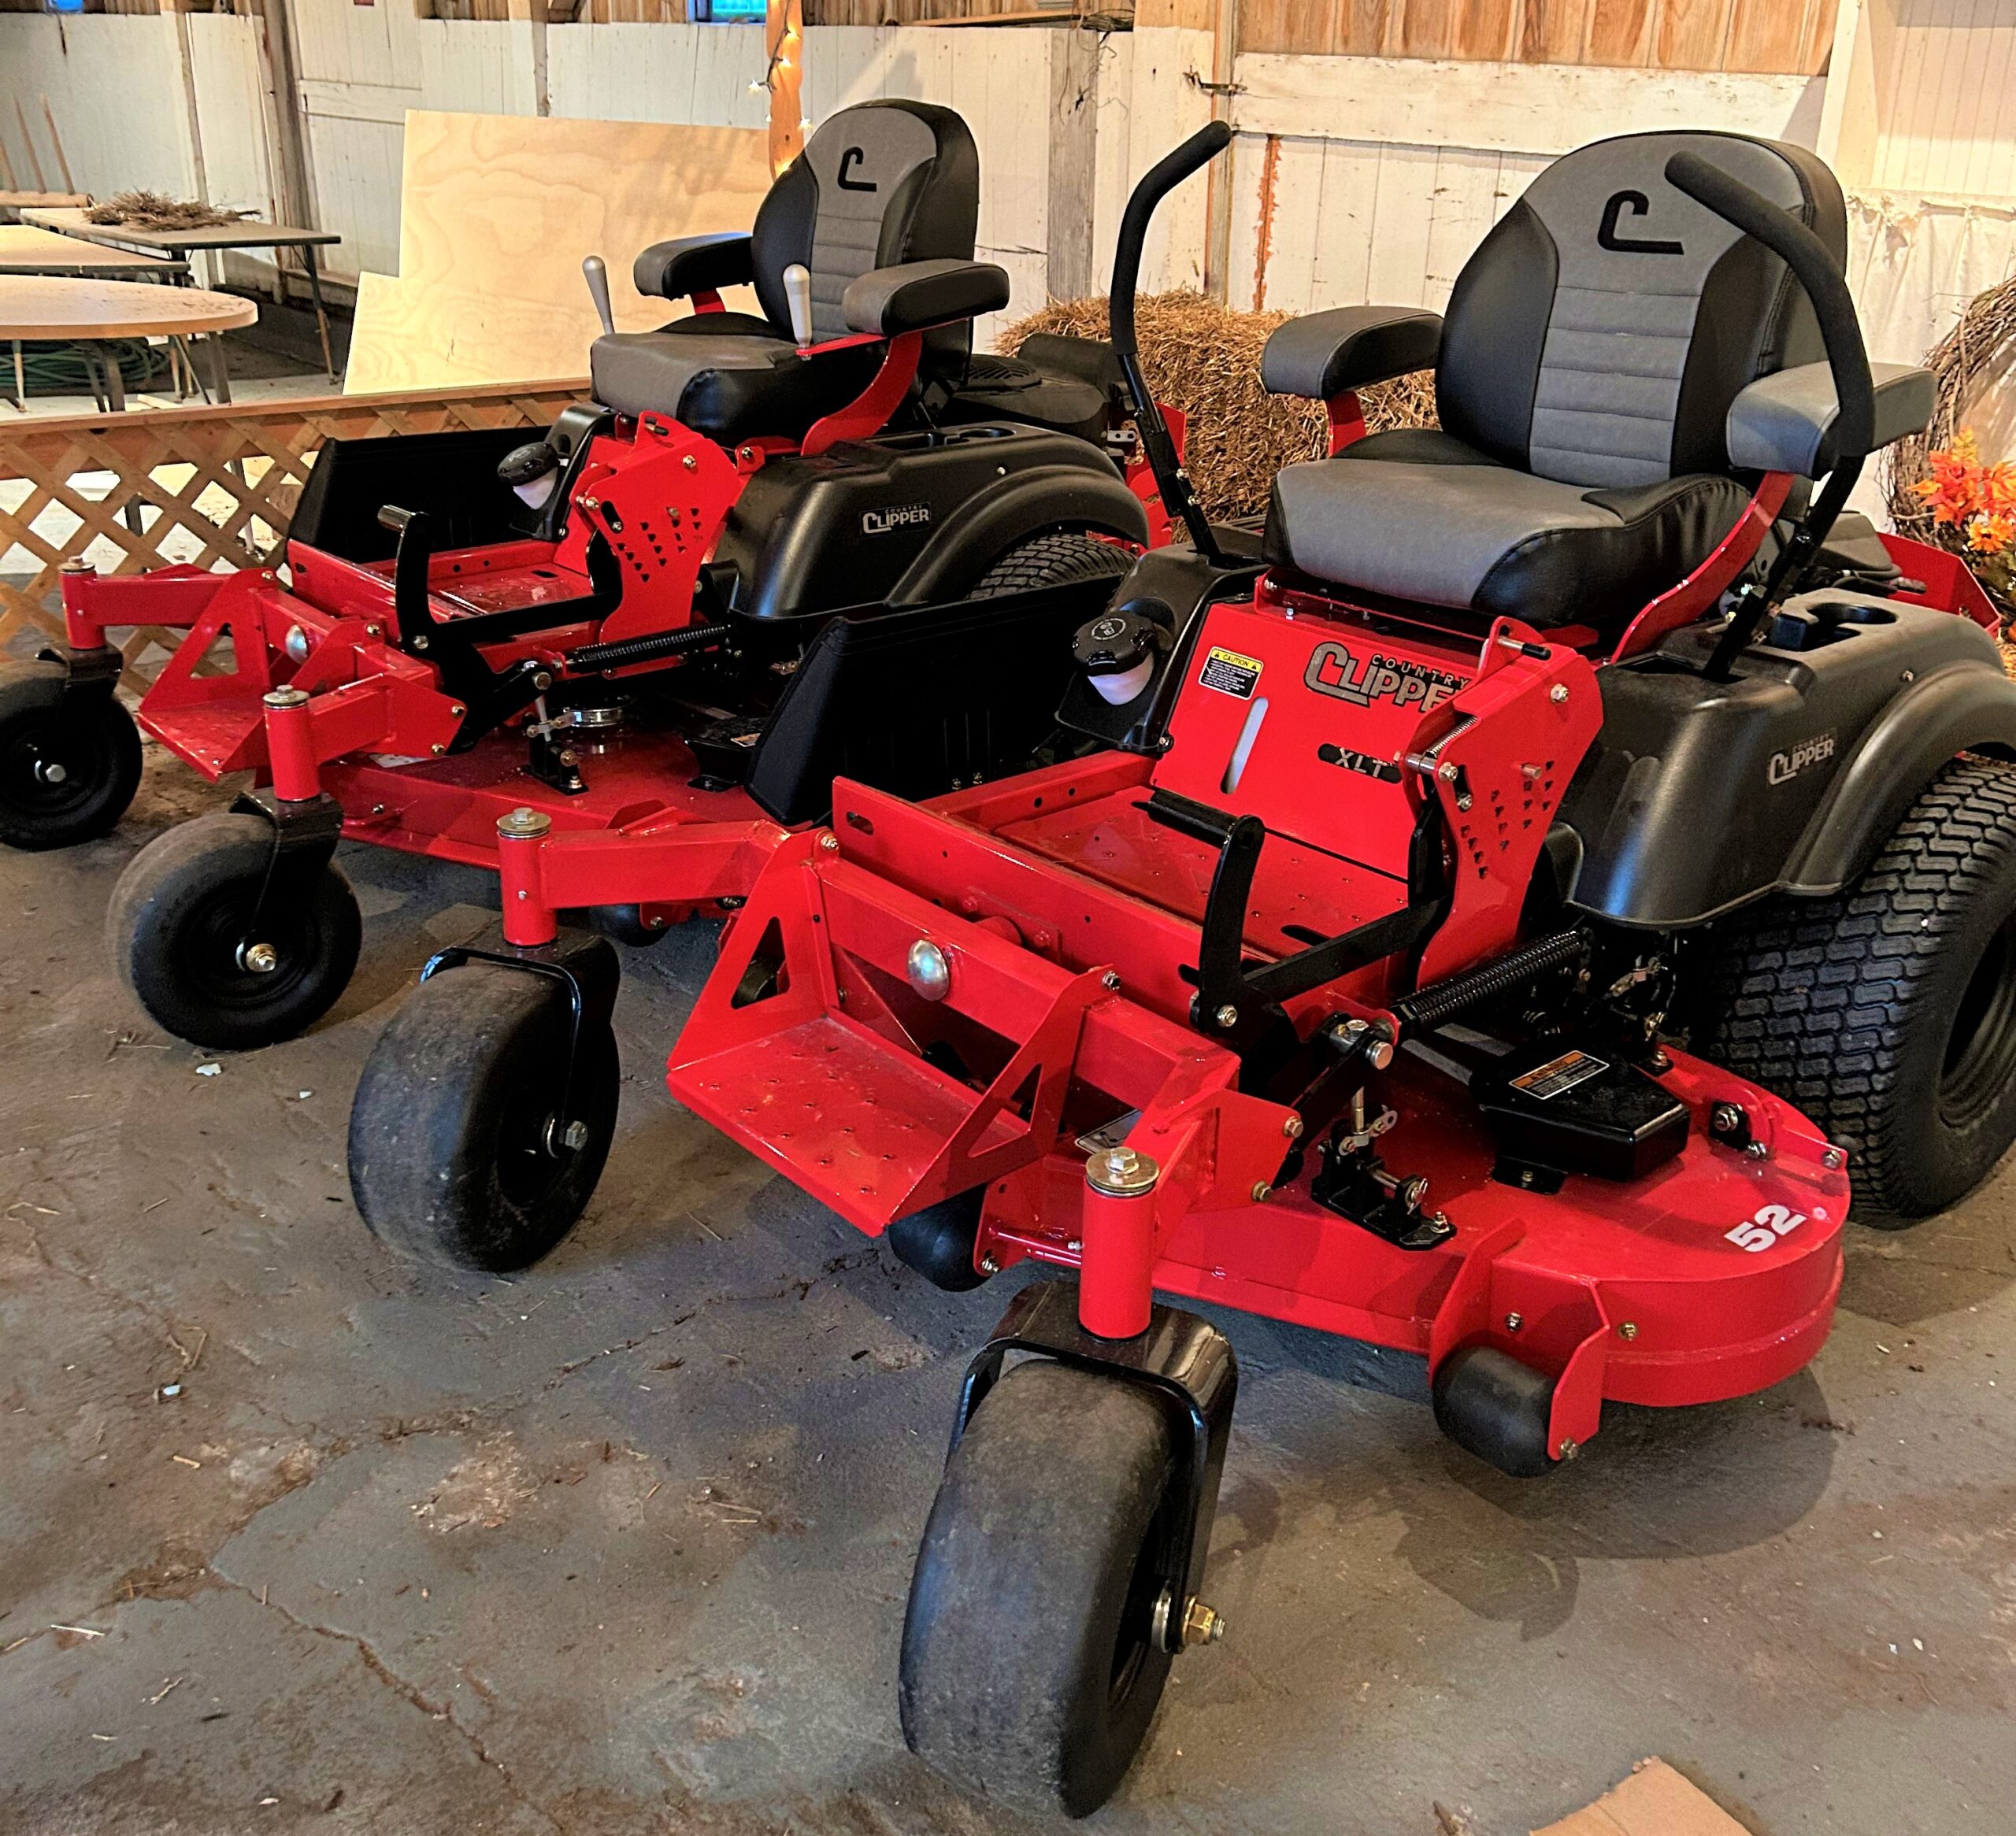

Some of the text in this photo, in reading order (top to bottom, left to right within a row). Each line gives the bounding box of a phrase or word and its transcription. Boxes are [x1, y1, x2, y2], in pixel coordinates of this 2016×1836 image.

[862, 512, 929, 534] CLIPPER
[885, 505, 922, 514] COUNTRY
[1222, 654, 1249, 668] CAUTION
[1305, 642, 1455, 712] CLIPPE
[1372, 654, 1471, 690] COUNTRY
[1336, 747, 1383, 778] XLT
[1770, 738, 1835, 786] CLIPPER
[1723, 1205, 1807, 1253] 52
